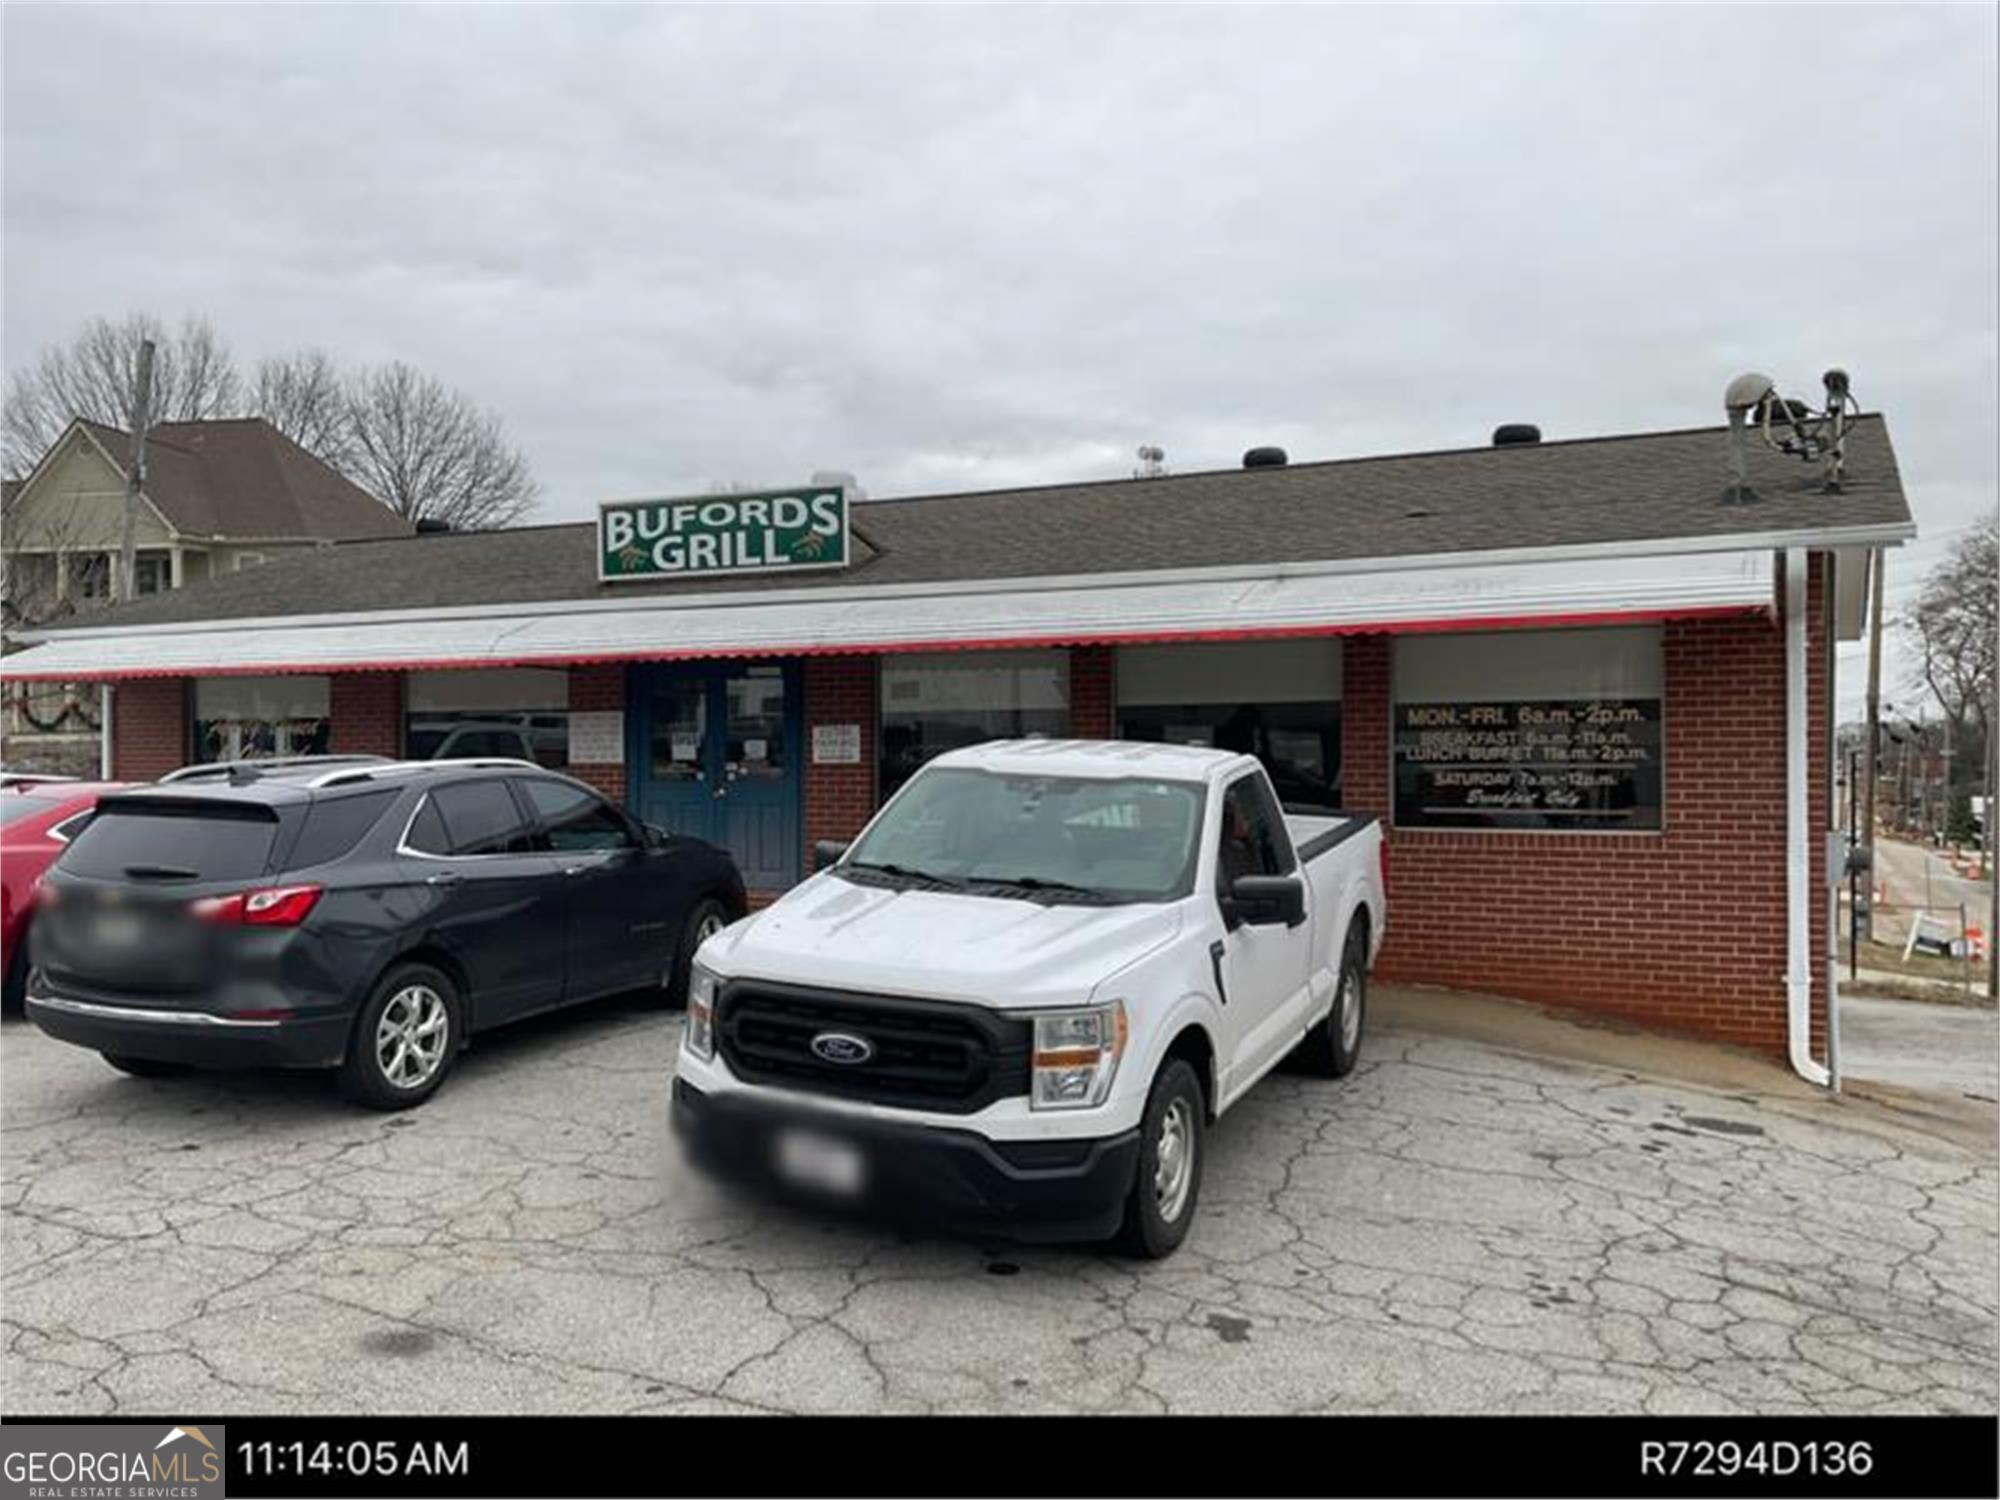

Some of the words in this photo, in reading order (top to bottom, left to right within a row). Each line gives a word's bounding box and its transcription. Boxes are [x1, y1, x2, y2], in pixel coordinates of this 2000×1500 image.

[606, 494, 840, 554] BUFORDS
[652, 528, 790, 571] GRILL
[1420, 731, 1518, 746] BREAKFAST
[1406, 747, 1463, 761] LUNCH
[1469, 746, 1534, 761] BUFFET
[1433, 772, 1512, 787] SATURDAY
